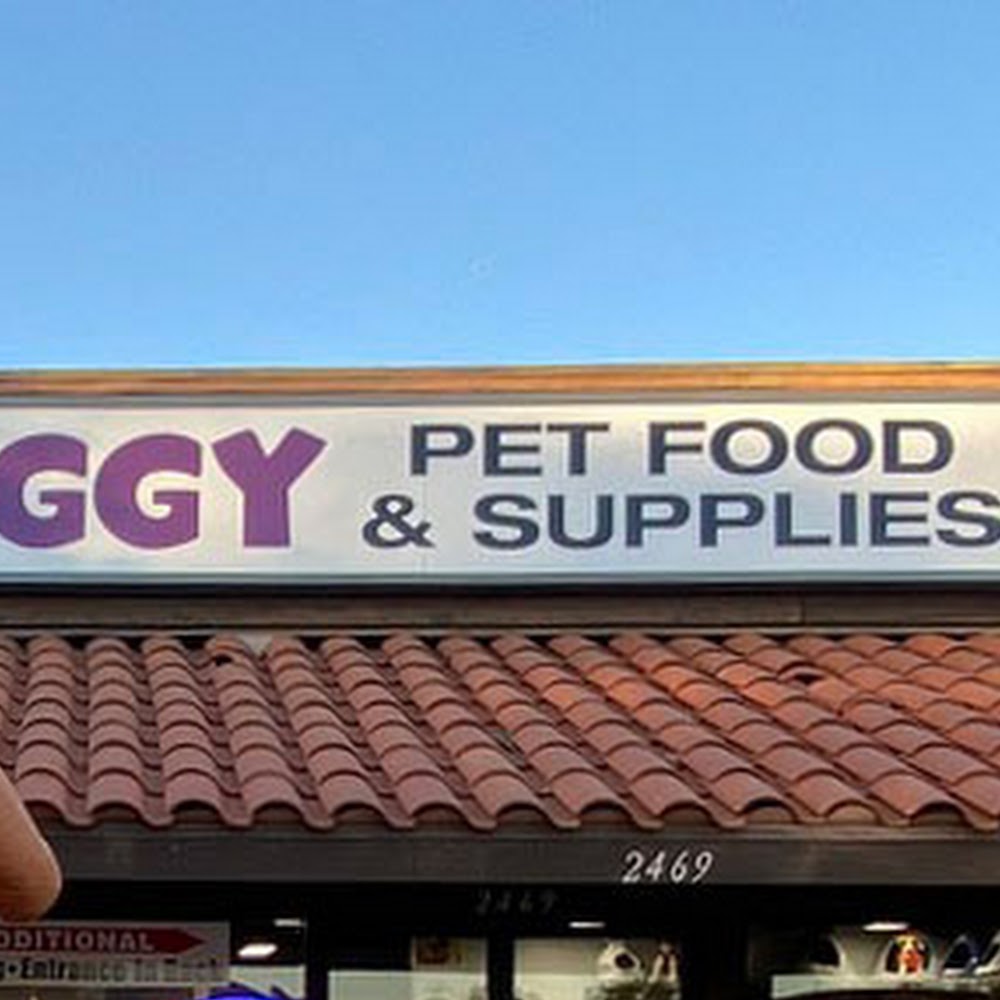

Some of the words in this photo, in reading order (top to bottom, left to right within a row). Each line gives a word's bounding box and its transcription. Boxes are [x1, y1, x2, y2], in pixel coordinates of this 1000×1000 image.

[410, 422, 610, 477] PET
[648, 419, 954, 476] FOOD
[362, 494, 435, 550] &
[473, 490, 1000, 551] SUPPLIES
[621, 850, 714, 884] 2469
